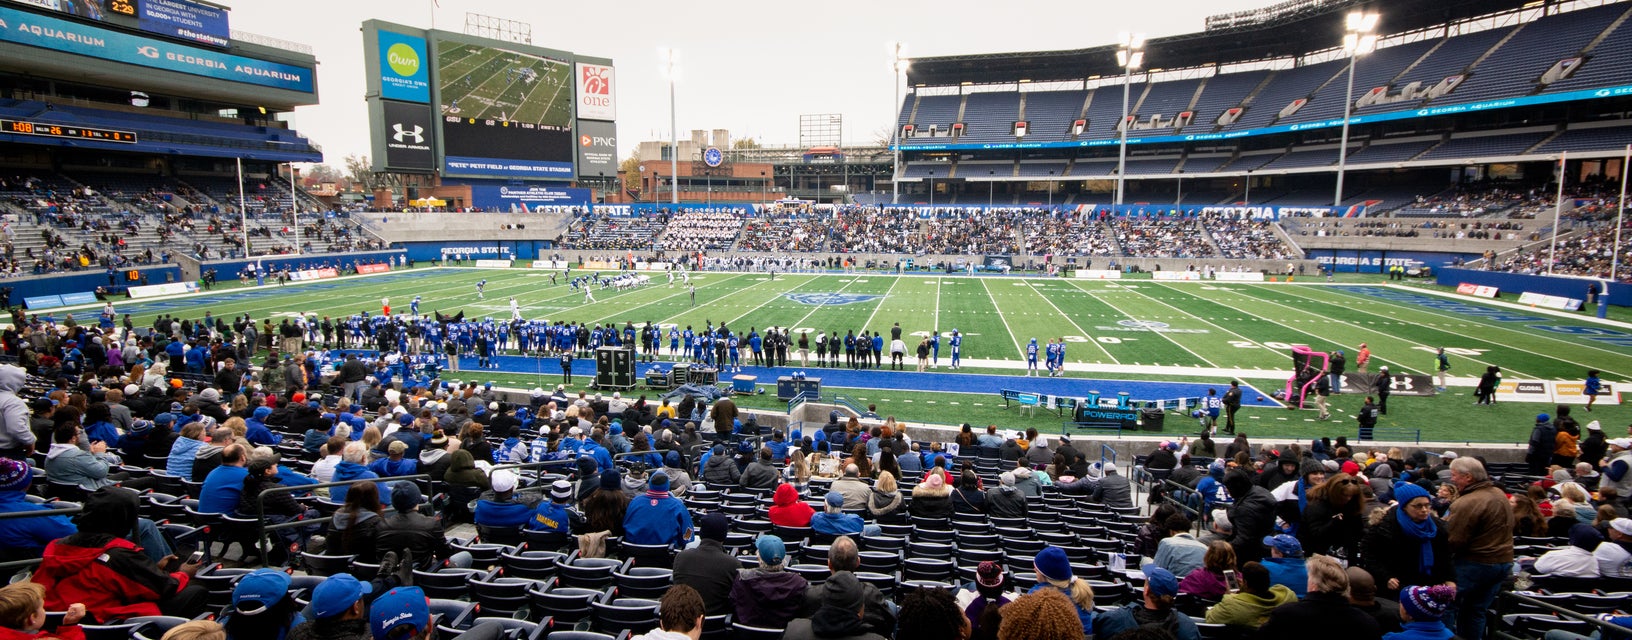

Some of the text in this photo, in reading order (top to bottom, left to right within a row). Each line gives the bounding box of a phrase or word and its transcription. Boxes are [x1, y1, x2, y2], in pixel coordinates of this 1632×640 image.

[112, 2, 134, 14] 2:29
[153, 5, 180, 16] GEORGIA
[188, 6, 220, 18] UNIVERSITY
[172, 16, 203, 28] STUDENTS
[18, 23, 104, 47] AQUARIUM
[390, 52, 417, 67] Own
[166, 52, 300, 82] GEORGIA AQUARIUM
[584, 96, 610, 106] one
[1470, 100, 1516, 110] AQUARIUM
[1328, 118, 1361, 126] AQUAIUM
[12, 122, 32, 133] 1:08
[50, 127, 61, 135] 26
[593, 136, 615, 146] PNC
[1316, 256, 1412, 266] GEORGIA STATE
[130, 270, 139, 280] 10
[1209, 399, 1220, 408] 93
